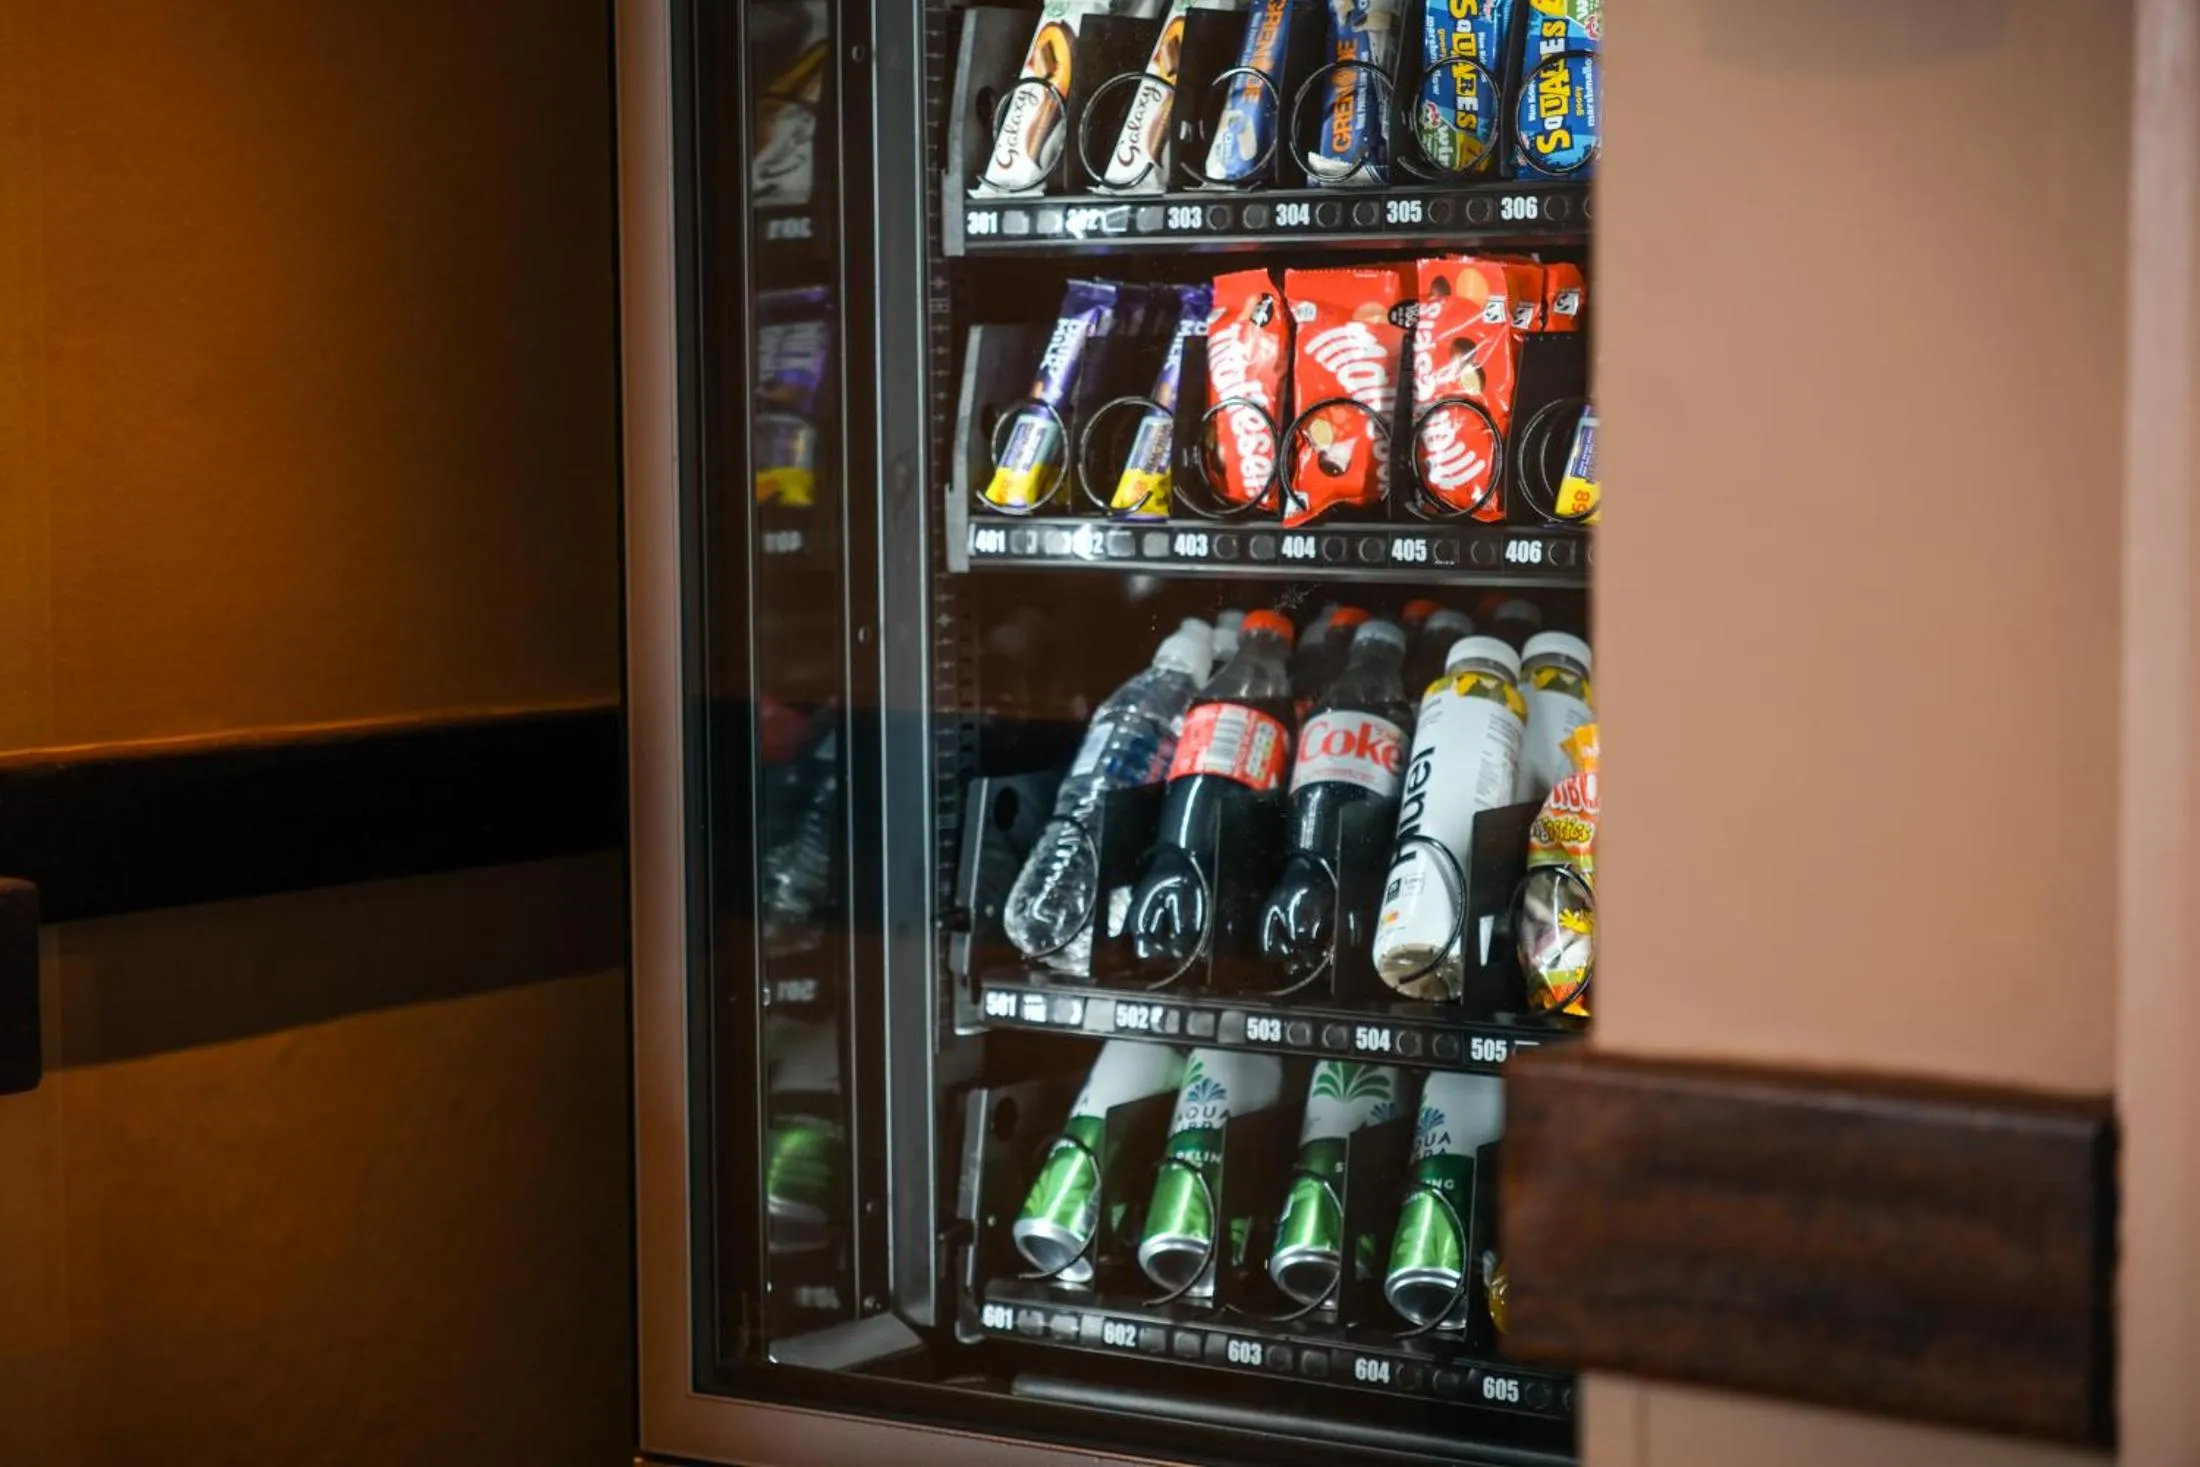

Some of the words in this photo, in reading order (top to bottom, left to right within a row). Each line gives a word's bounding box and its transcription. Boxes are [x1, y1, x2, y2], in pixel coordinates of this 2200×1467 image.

[1582, 48, 1596, 127] marshmallo
[995, 88, 1039, 169] Galaxy
[1117, 85, 1162, 167] Galaxy
[1168, 206, 1202, 229] 303
[1276, 203, 1310, 226] 304
[1386, 200, 1422, 223] 305
[1501, 196, 1538, 220] 306
[967, 211, 998, 234] 301
[974, 529, 1006, 553] 401
[1174, 534, 1209, 557] 403
[1282, 535, 1316, 559] 404
[1391, 538, 1427, 562] 405
[1505, 540, 1542, 563] 406
[1299, 721, 1404, 777] Coke
[1116, 1004, 1149, 1029] 502
[1247, 1017, 1281, 1042] 503
[1355, 1027, 1390, 1051] 504
[1471, 1037, 1507, 1062] 505
[982, 1304, 1014, 1330] 601
[1103, 1321, 1137, 1347] 602
[1227, 1340, 1262, 1365] 603
[1354, 1357, 1390, 1384] 604
[1482, 1376, 1519, 1403] 605
